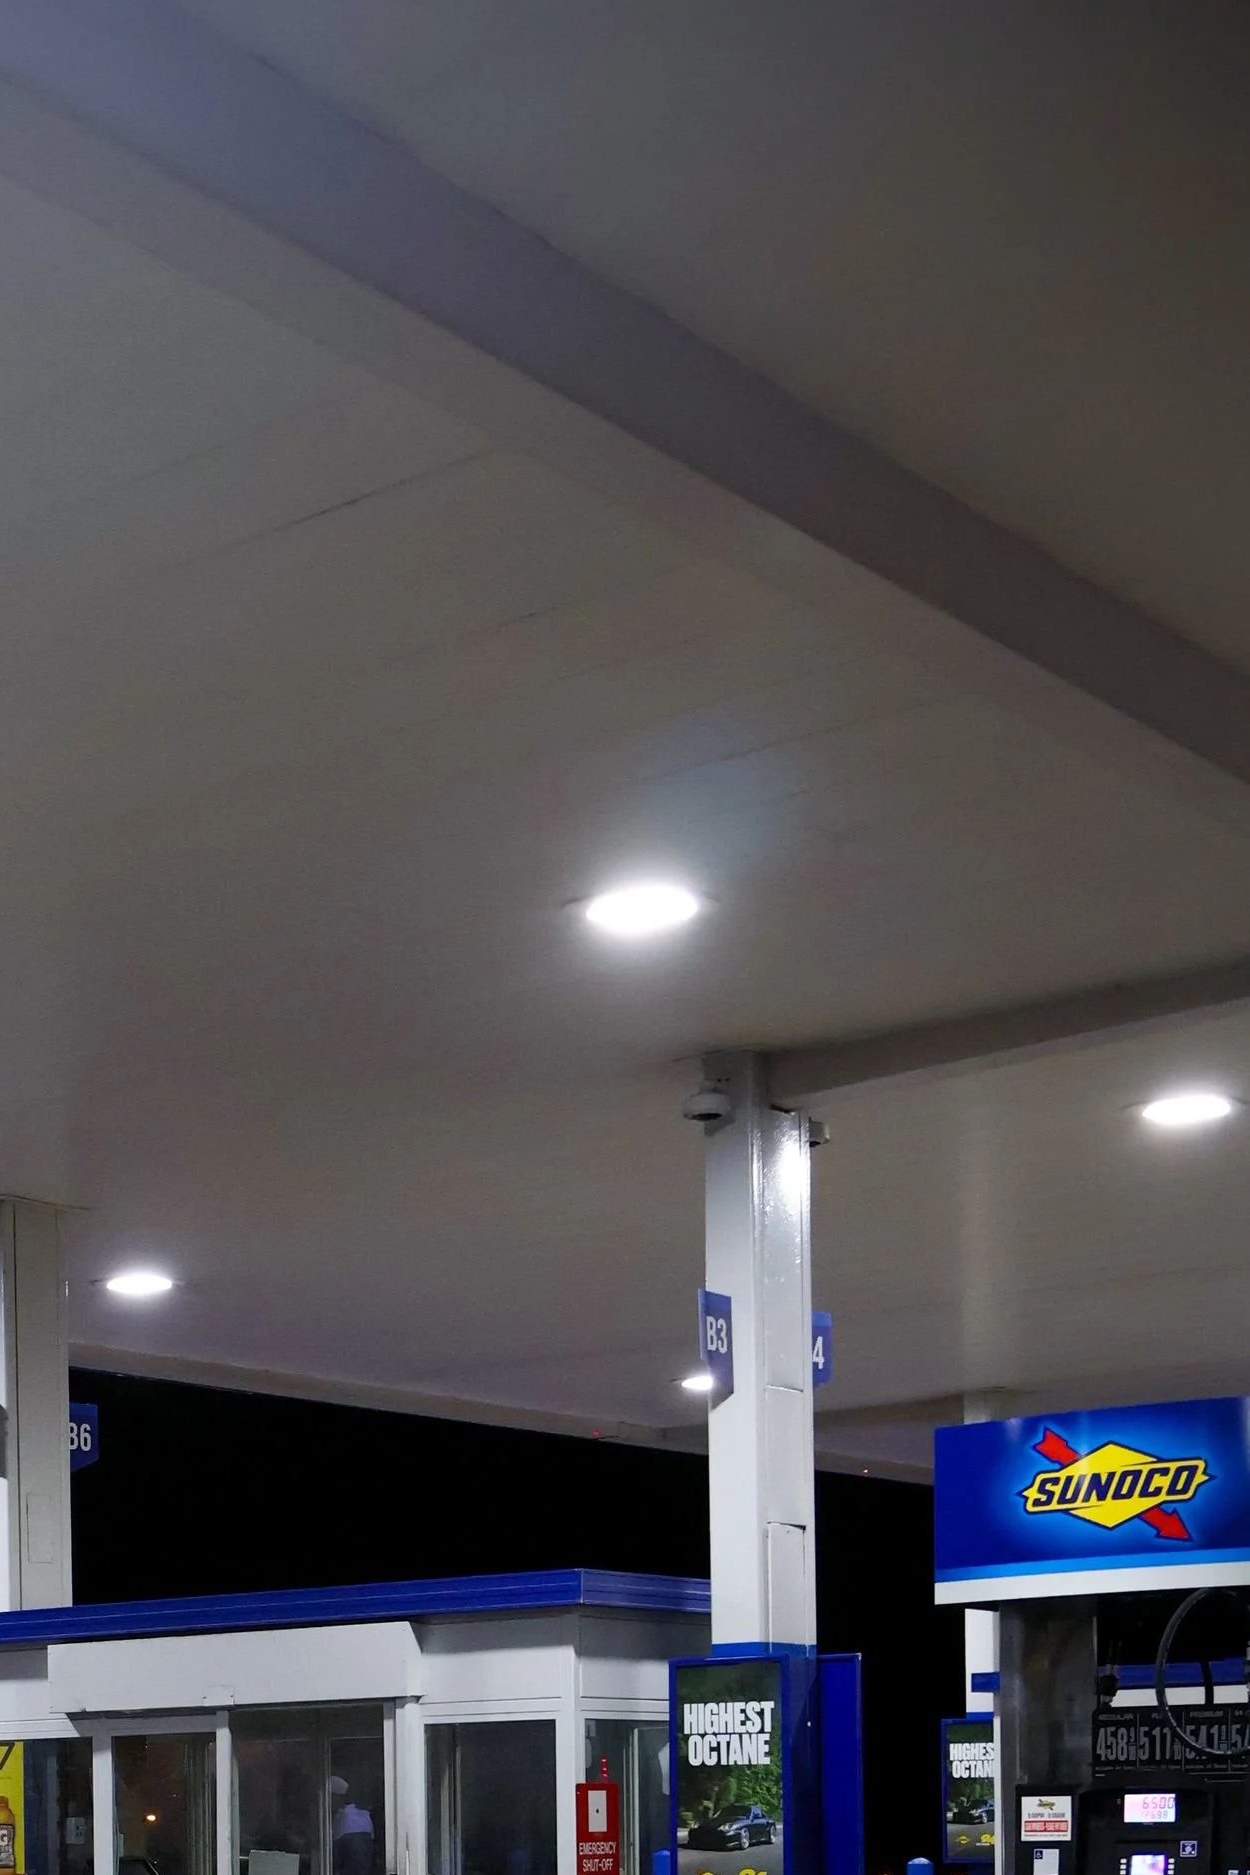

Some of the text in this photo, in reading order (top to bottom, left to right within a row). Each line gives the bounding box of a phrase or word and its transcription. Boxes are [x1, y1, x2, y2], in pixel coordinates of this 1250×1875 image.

[706, 1315, 728, 1354] B3
[812, 1336, 825, 1370] 4
[69, 1423, 92, 1451] B6
[1032, 1464, 1200, 1507] SUNOCO
[683, 1701, 775, 1735] HIGHEST
[687, 1733, 771, 1766] OCTANE
[949, 1742, 994, 1761] HIGHES
[952, 1760, 994, 1779] OCTAN
[579, 1842, 617, 1855] EMERGENCY
[582, 1858, 614, 1872] SHUT-OFF
